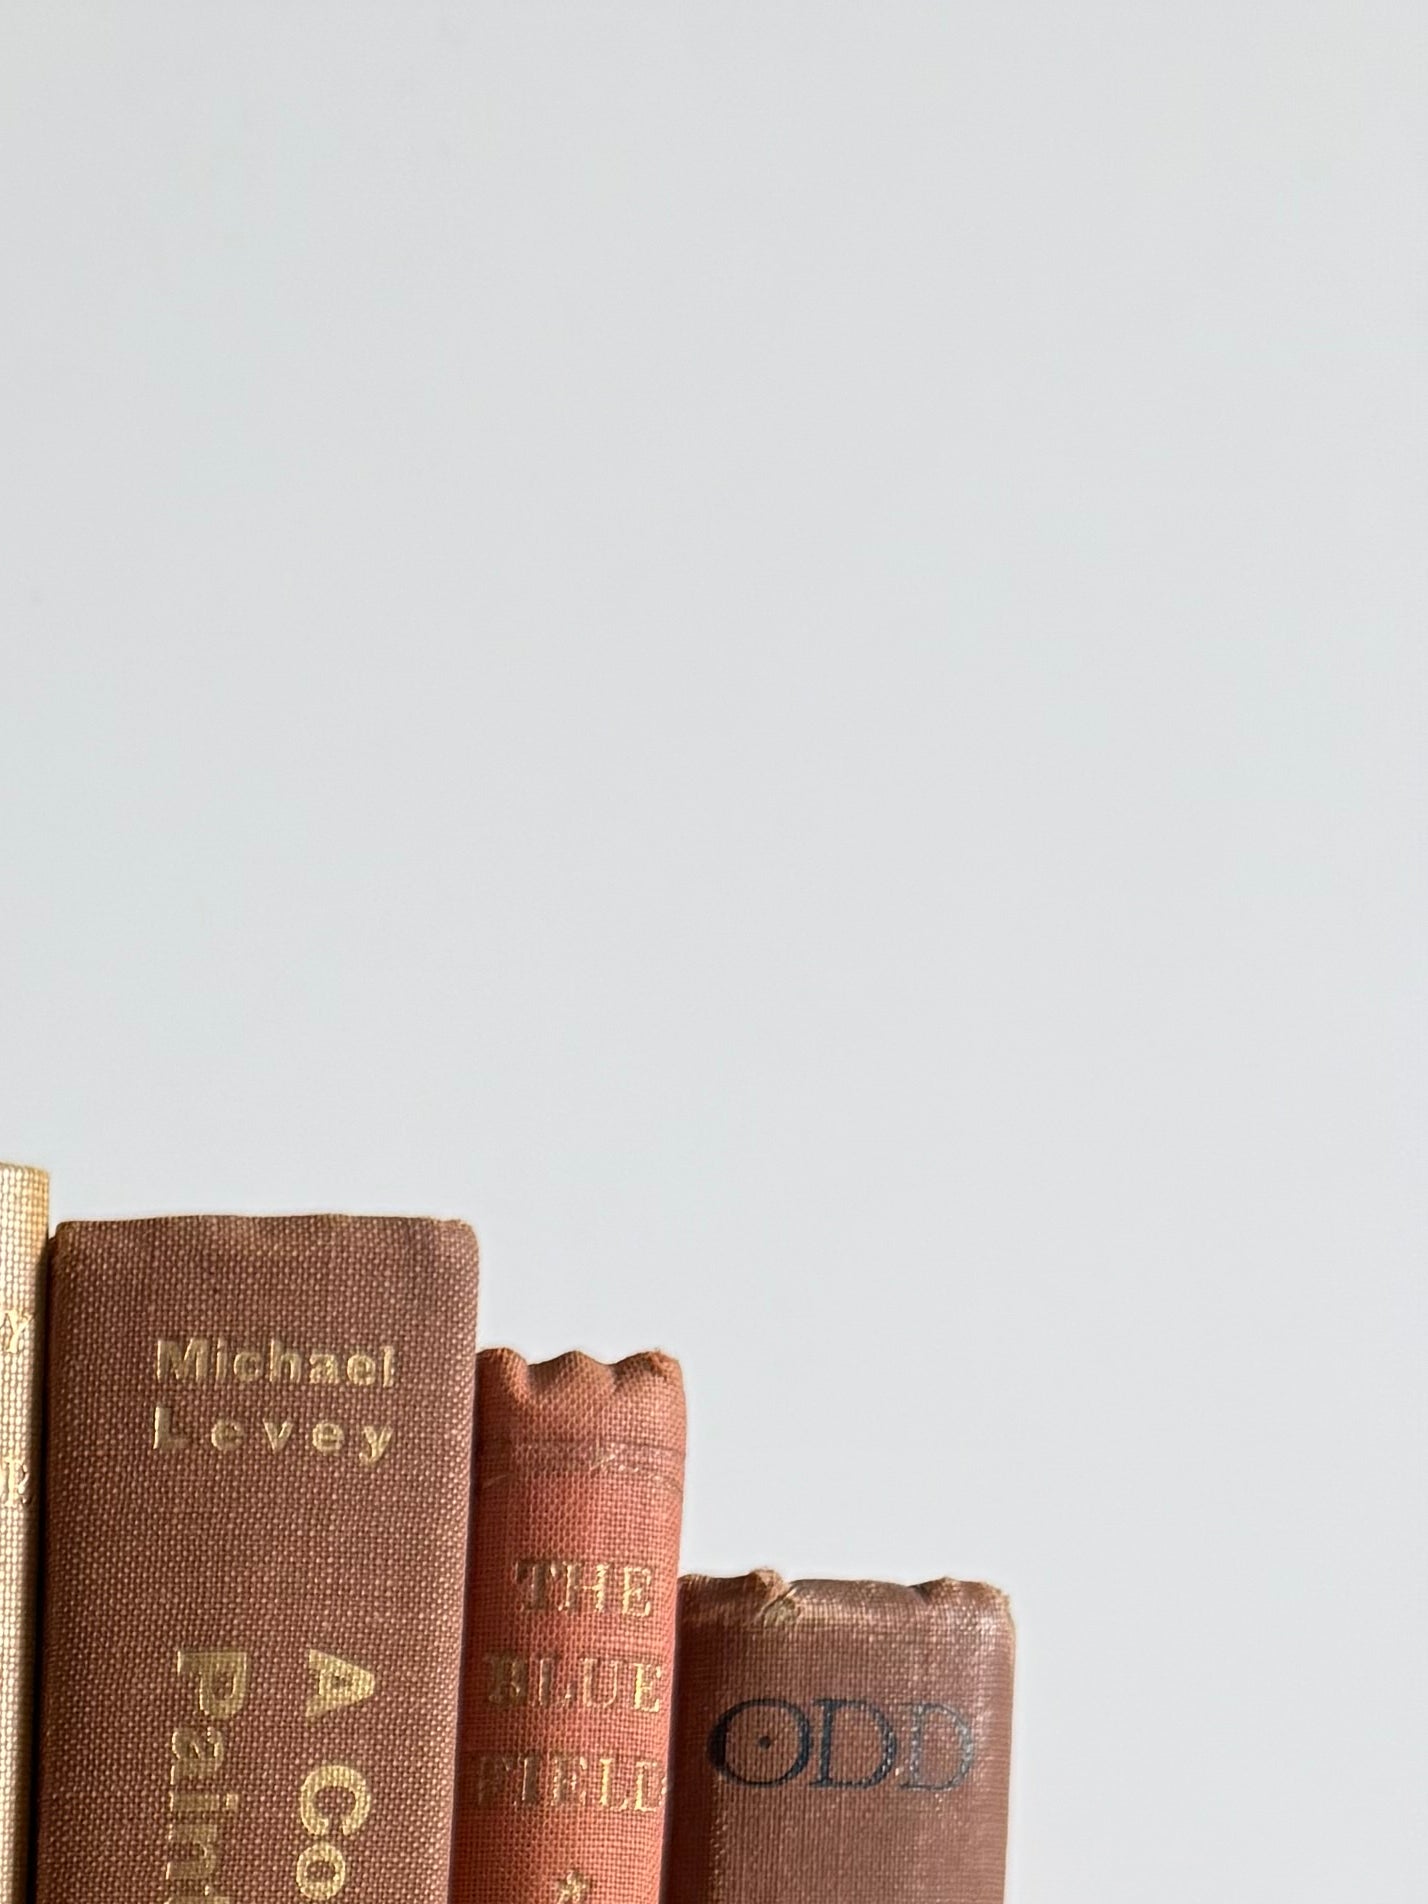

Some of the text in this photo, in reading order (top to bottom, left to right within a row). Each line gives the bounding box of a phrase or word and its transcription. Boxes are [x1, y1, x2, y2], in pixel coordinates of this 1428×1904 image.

[155, 1338, 395, 1389] Michael
[153, 1405, 393, 1467] Levey
[515, 1560, 652, 1618] THE
[305, 1649, 377, 1719] A
[486, 1652, 663, 1713] BLUE
[707, 1696, 976, 1793] ODD
[476, 1752, 669, 1813] FIELD
